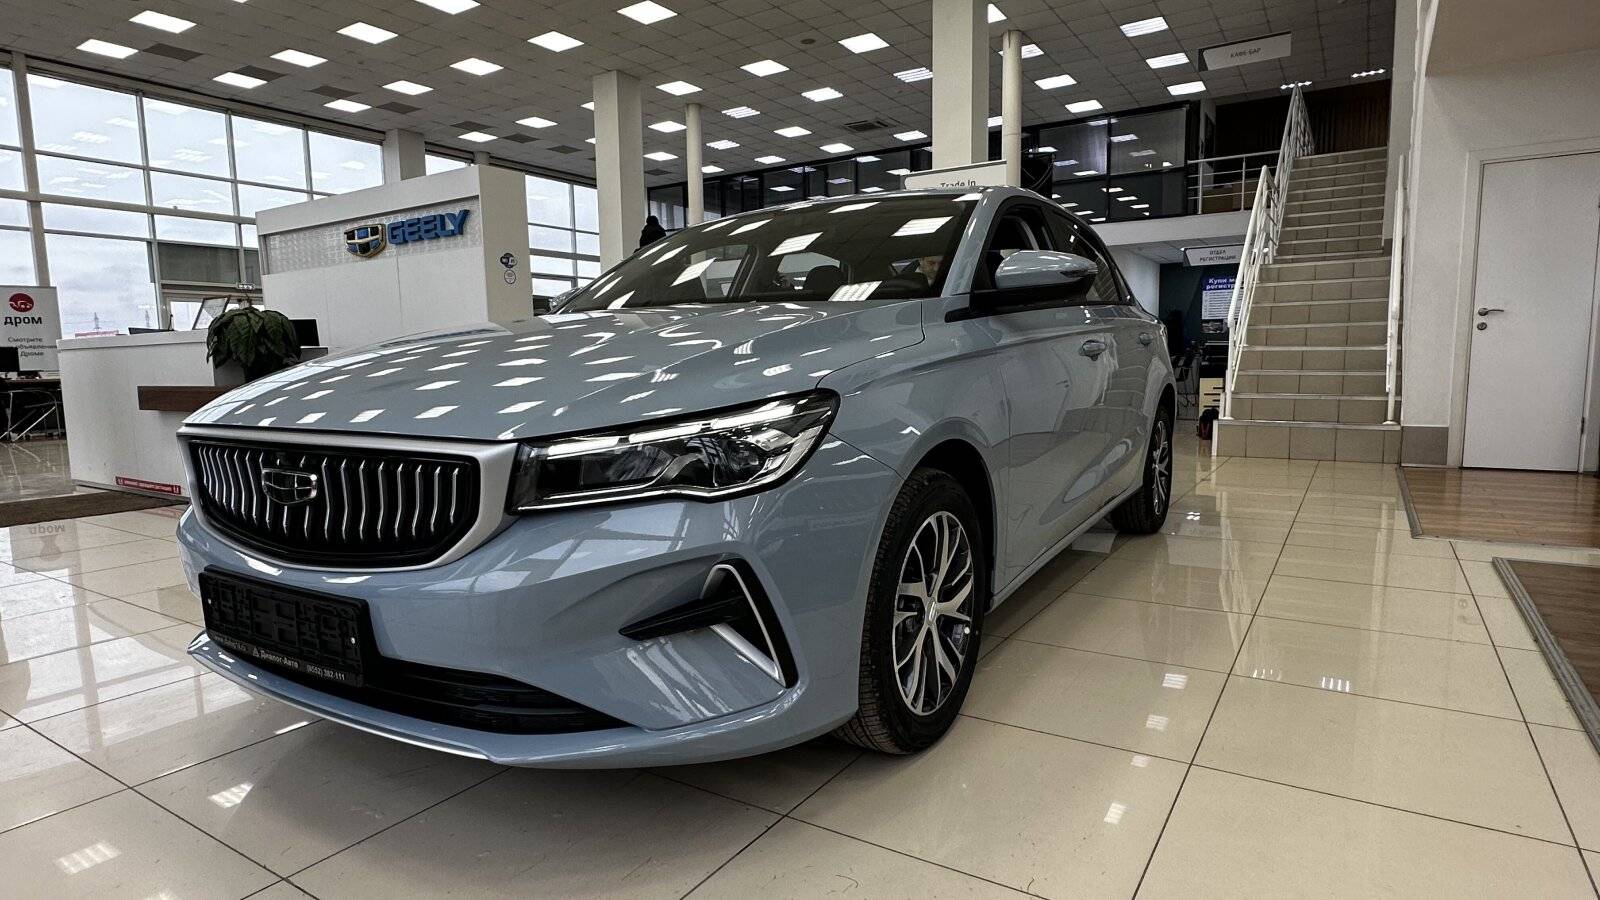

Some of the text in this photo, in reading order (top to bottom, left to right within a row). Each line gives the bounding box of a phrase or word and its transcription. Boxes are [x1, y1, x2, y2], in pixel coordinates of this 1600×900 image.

[1230, 48, 1261, 58] КАФЕ-БАР
[387, 209, 470, 246] GEELY
[4, 316, 43, 327] дром
